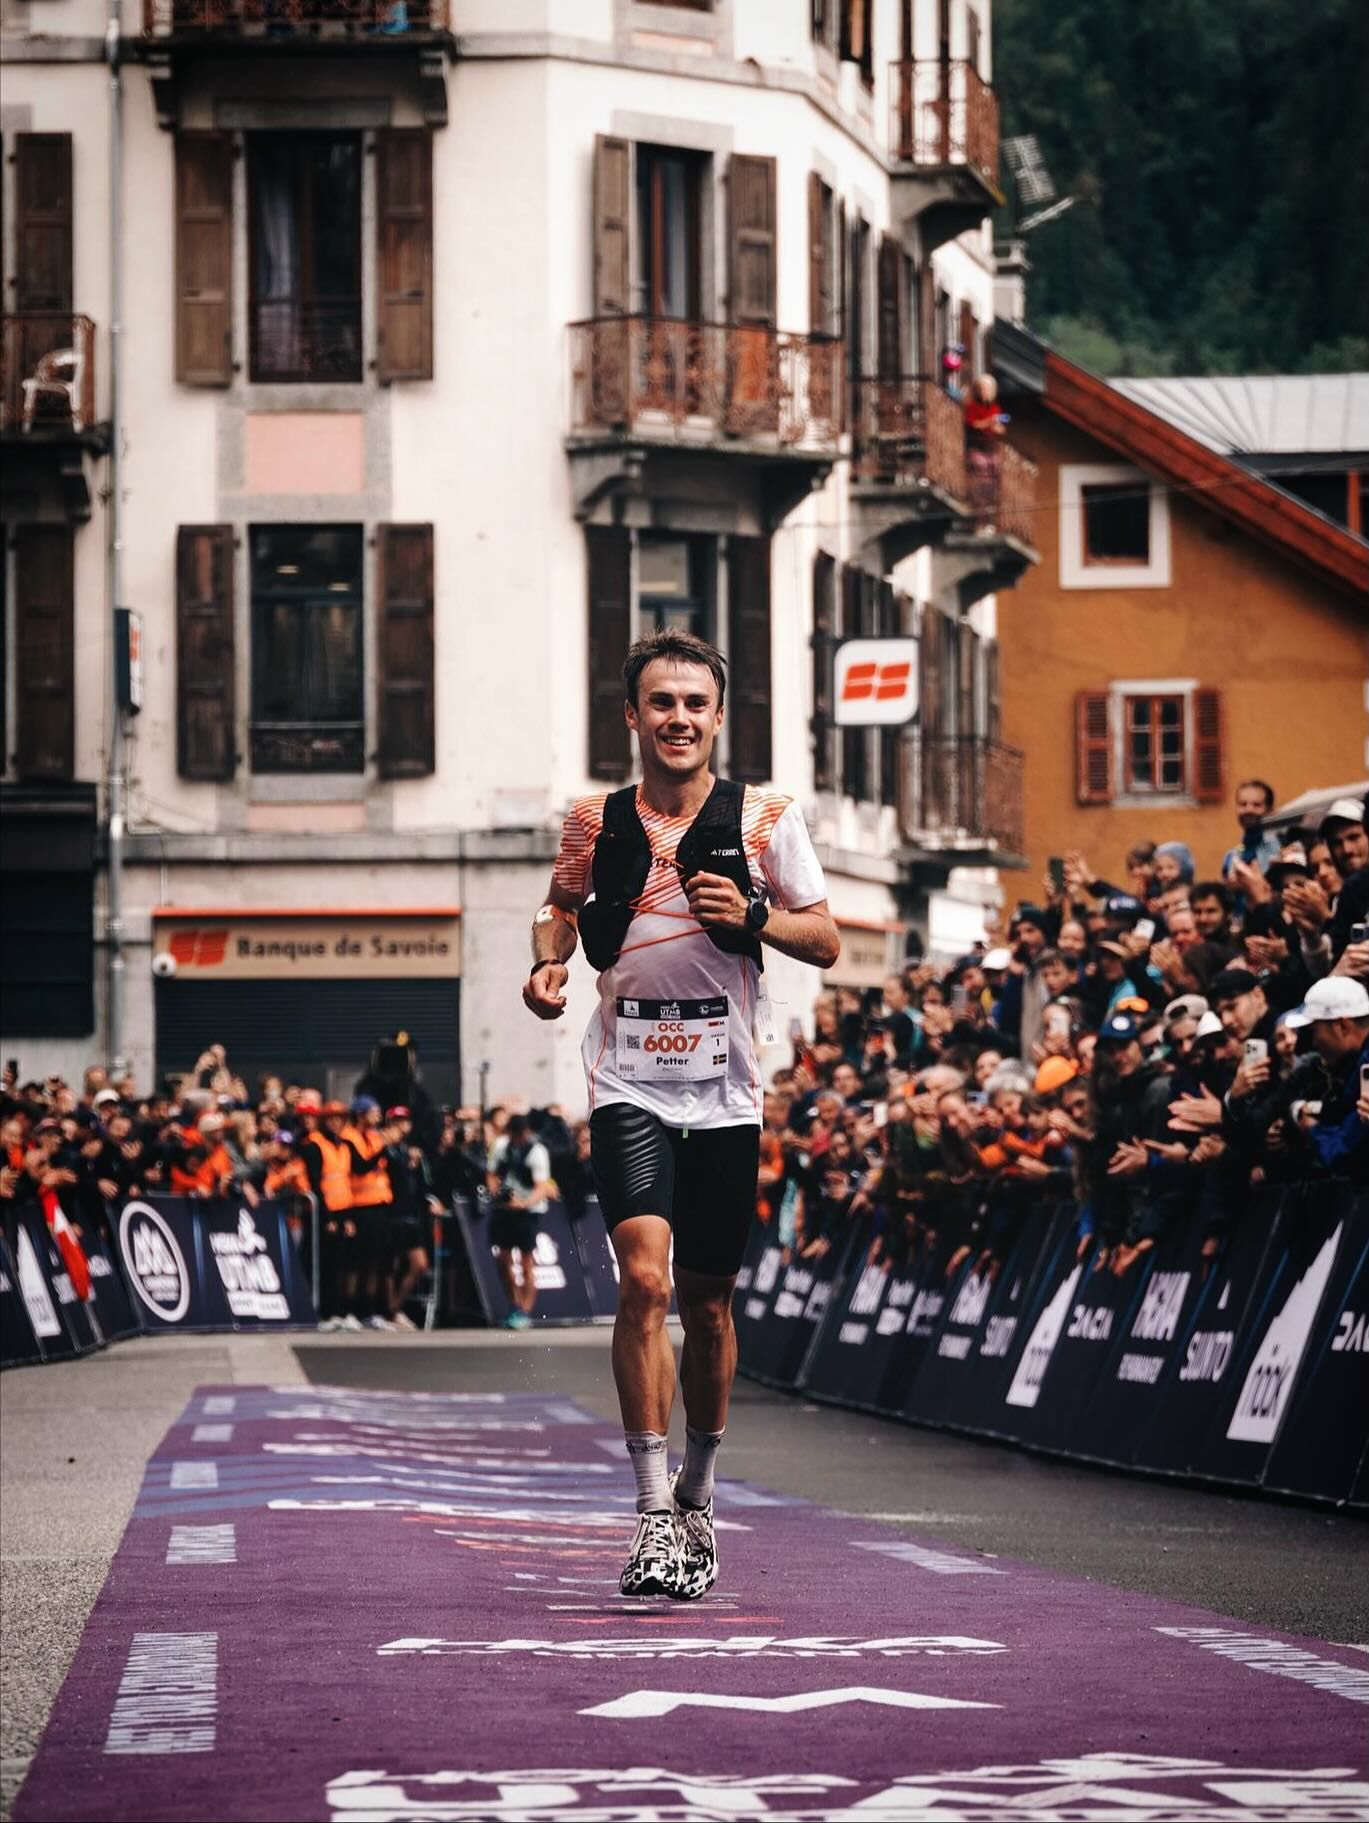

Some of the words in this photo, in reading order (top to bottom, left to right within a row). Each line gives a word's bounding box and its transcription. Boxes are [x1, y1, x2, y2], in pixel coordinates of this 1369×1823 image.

[237, 936, 326, 962] Banque
[335, 935, 362, 958] de
[370, 935, 450, 959] Savoie
[658, 1022, 685, 1033] OCC
[643, 1034, 703, 1054] 6007
[656, 1056, 690, 1067] Petter
[376, 1636, 1008, 1652] HOKA
[326, 1767, 859, 1788] HOKA
